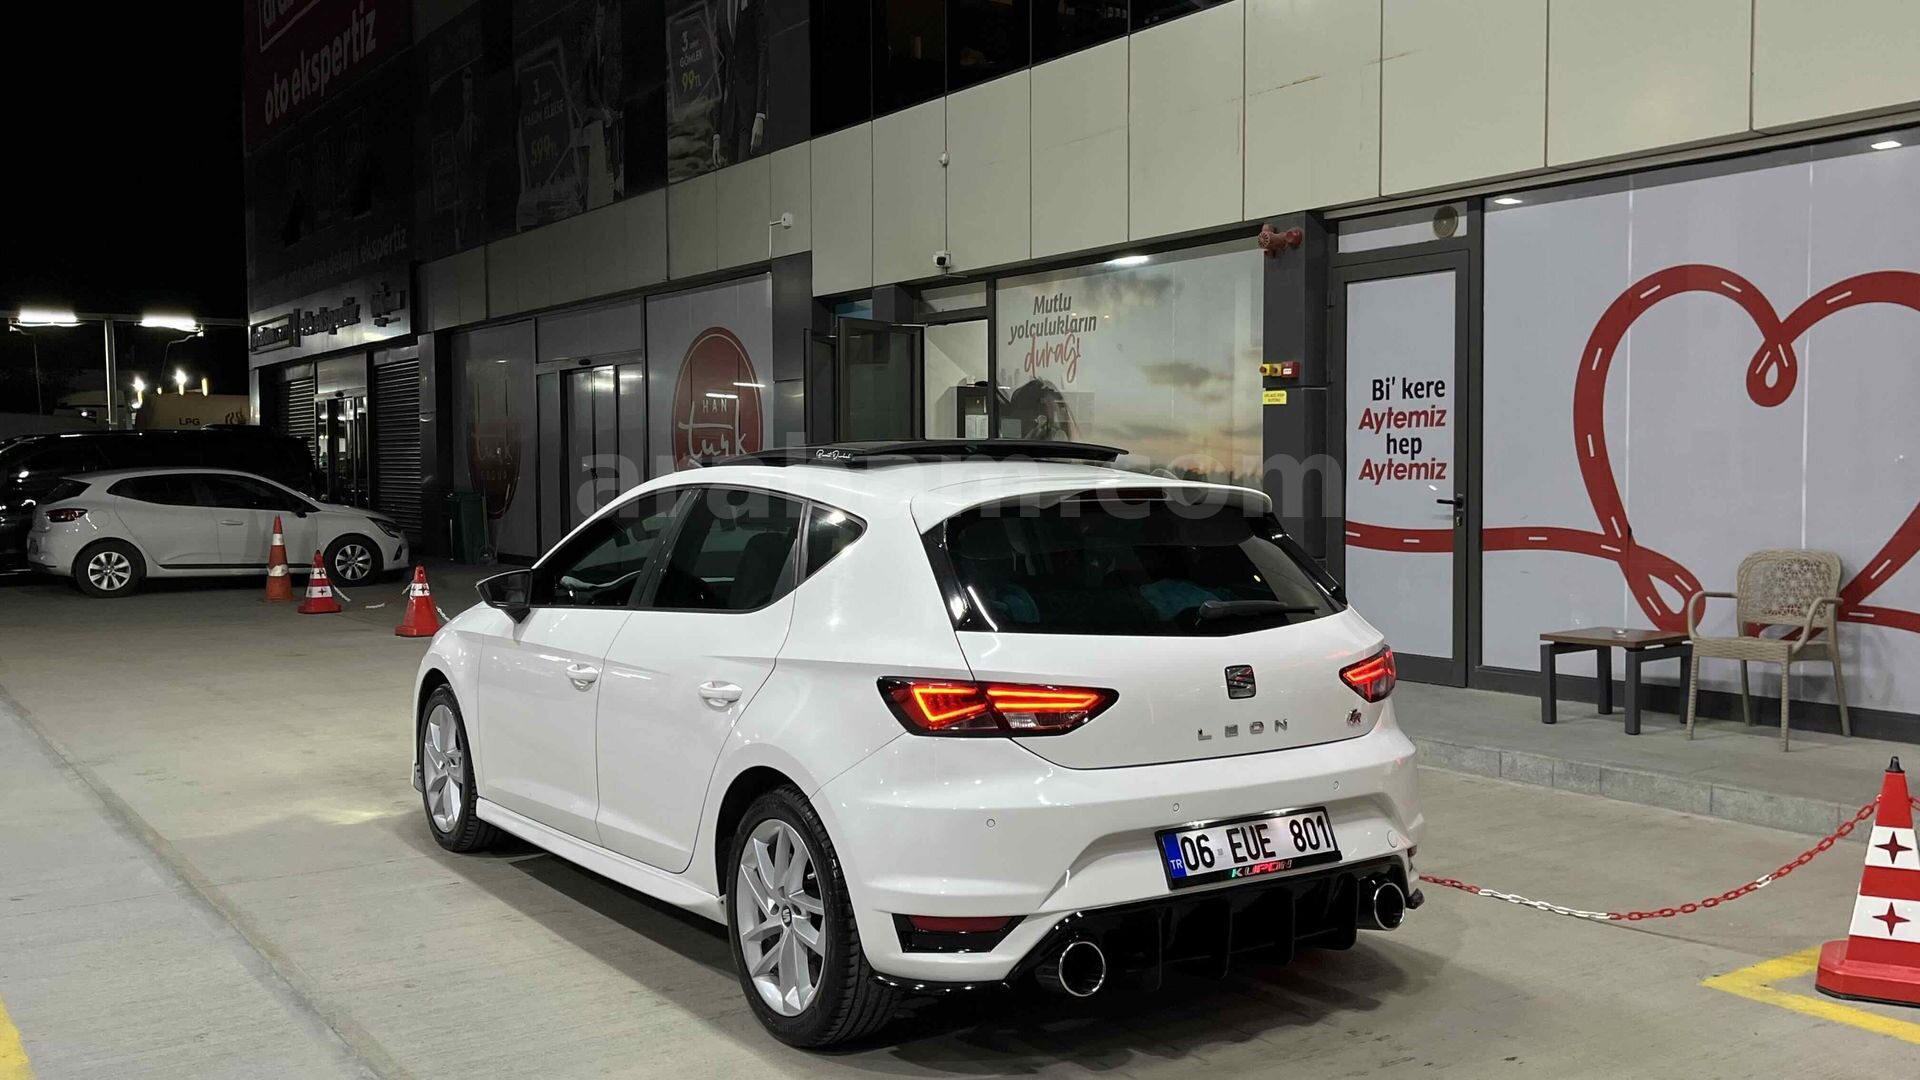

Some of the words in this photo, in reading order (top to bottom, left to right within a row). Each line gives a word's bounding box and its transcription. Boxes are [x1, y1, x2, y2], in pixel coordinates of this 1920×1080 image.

[265, 72, 289, 125] oto
[291, 0, 377, 105] ekspertiz
[1033, 293, 1072, 315] Mutlu
[1008, 315, 1097, 345] yolculukların
[1402, 377, 1445, 399] kere
[702, 399, 728, 413] HAN
[1358, 404, 1447, 434] Aytemiz
[178, 417, 201, 426] LPG
[1386, 433, 1422, 460] hep
[1358, 457, 1447, 485] Aytemiz
[1198, 719, 1288, 741] LEON
[1170, 859, 1183, 870] TR
[1180, 834, 1215, 871] 06
[1226, 823, 1276, 864] EUE
[1289, 815, 1331, 852] 801
